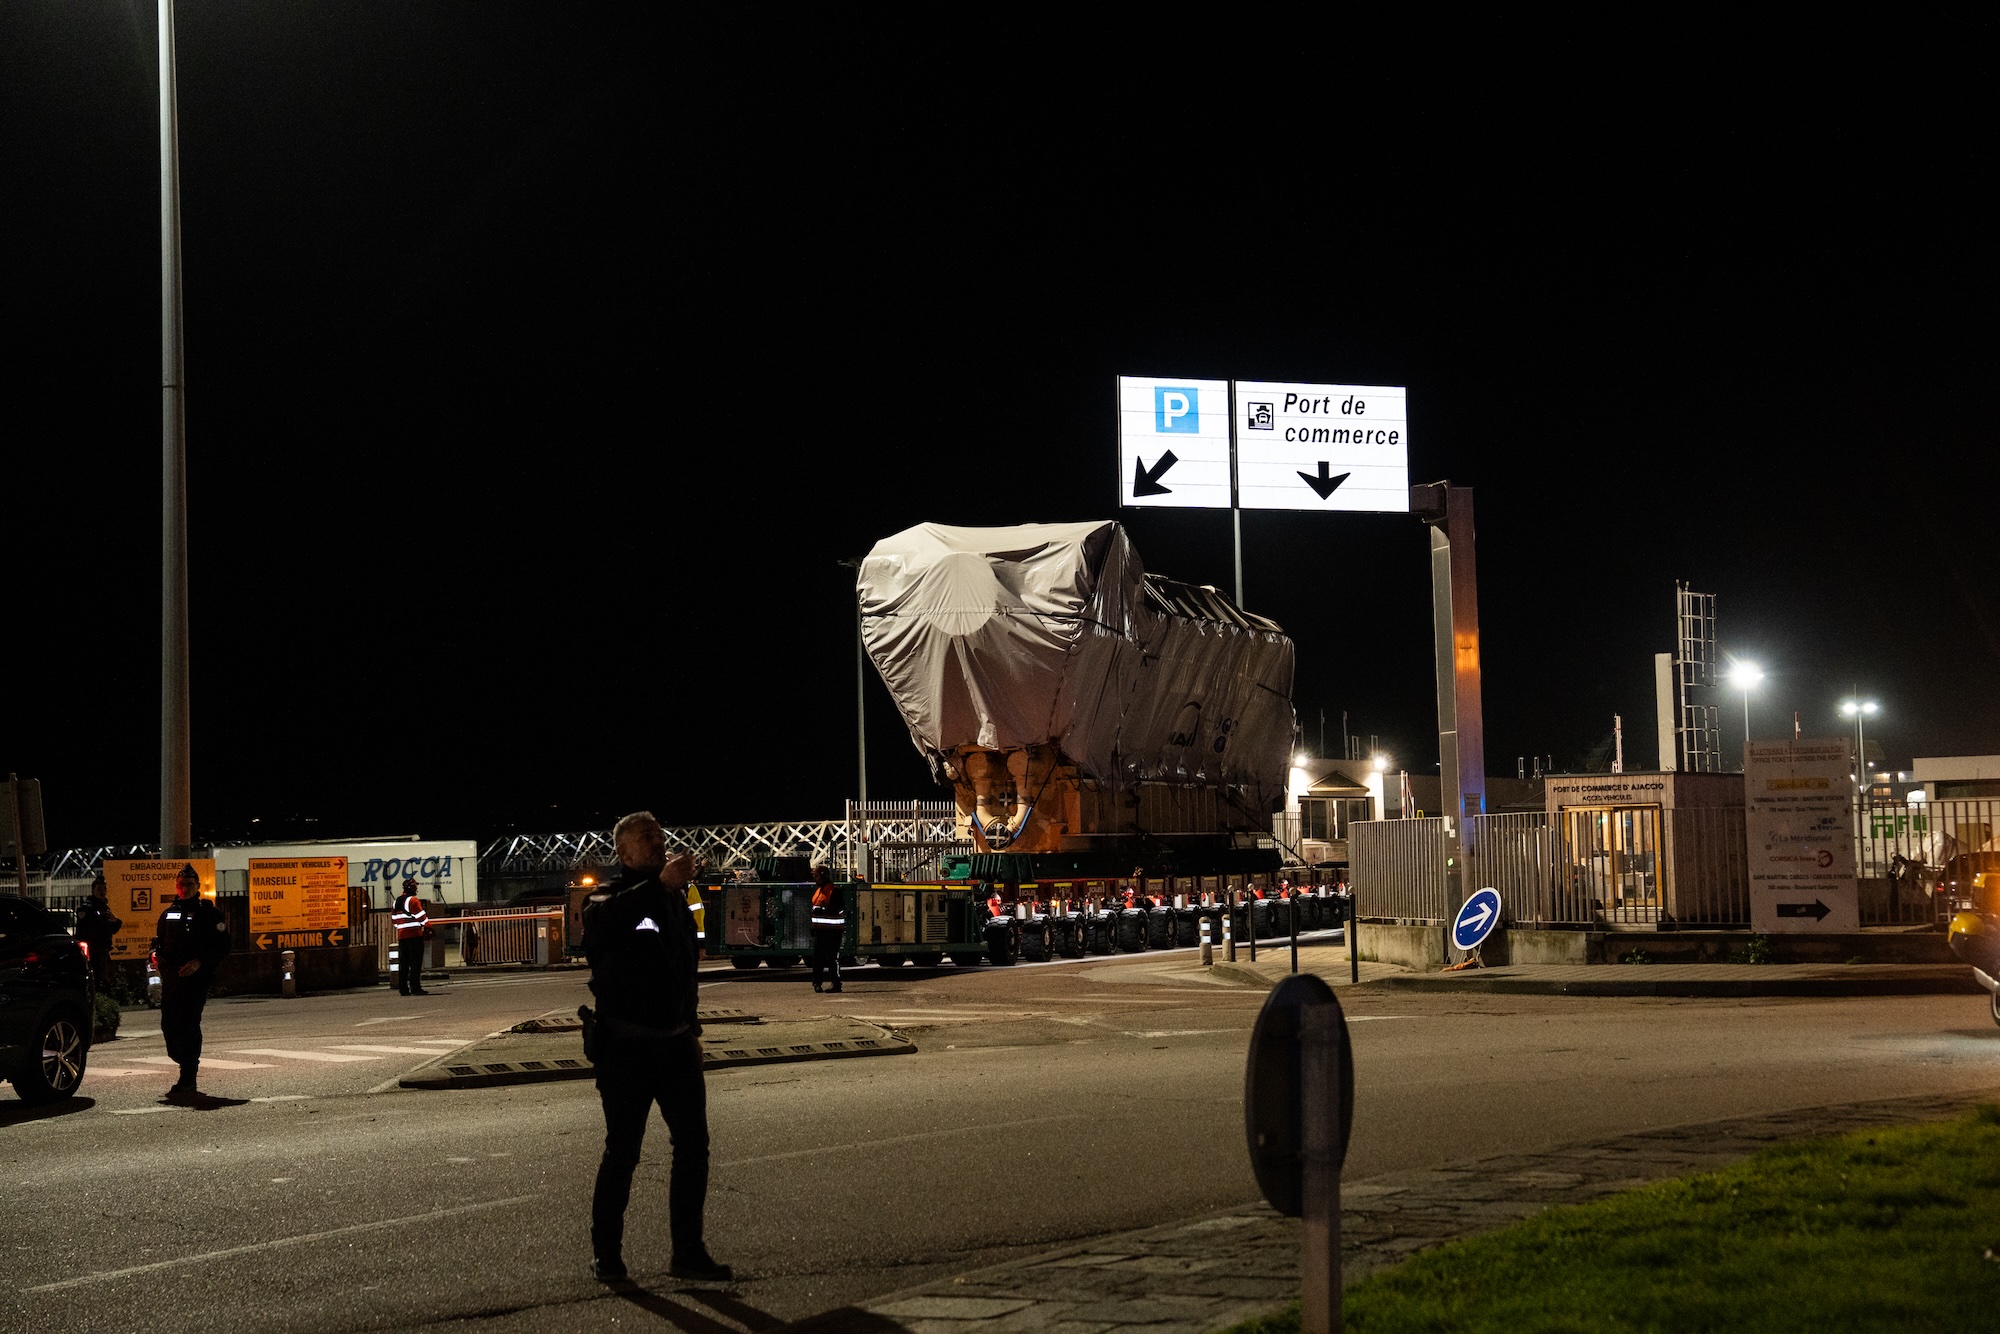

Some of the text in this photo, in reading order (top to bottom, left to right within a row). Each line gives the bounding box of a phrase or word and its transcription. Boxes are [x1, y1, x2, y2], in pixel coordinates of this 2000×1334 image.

[1284, 393, 1365, 415] Port de
[1163, 391, 1189, 428] P
[1285, 427, 1400, 446] commerce
[1571, 785, 1580, 793] DE
[1581, 784, 1621, 792] COMMERCE
[1631, 783, 1664, 791] AJACCIO
[1779, 834, 1788, 842] La
[301, 860, 331, 868] VÉHICULES
[361, 856, 451, 882] ROCCA
[122, 874, 151, 882] TOUTES
[252, 876, 297, 886] MARSEILLE
[253, 891, 284, 901] TOULON
[252, 905, 271, 914] NICE
[277, 932, 323, 948] PARKING
